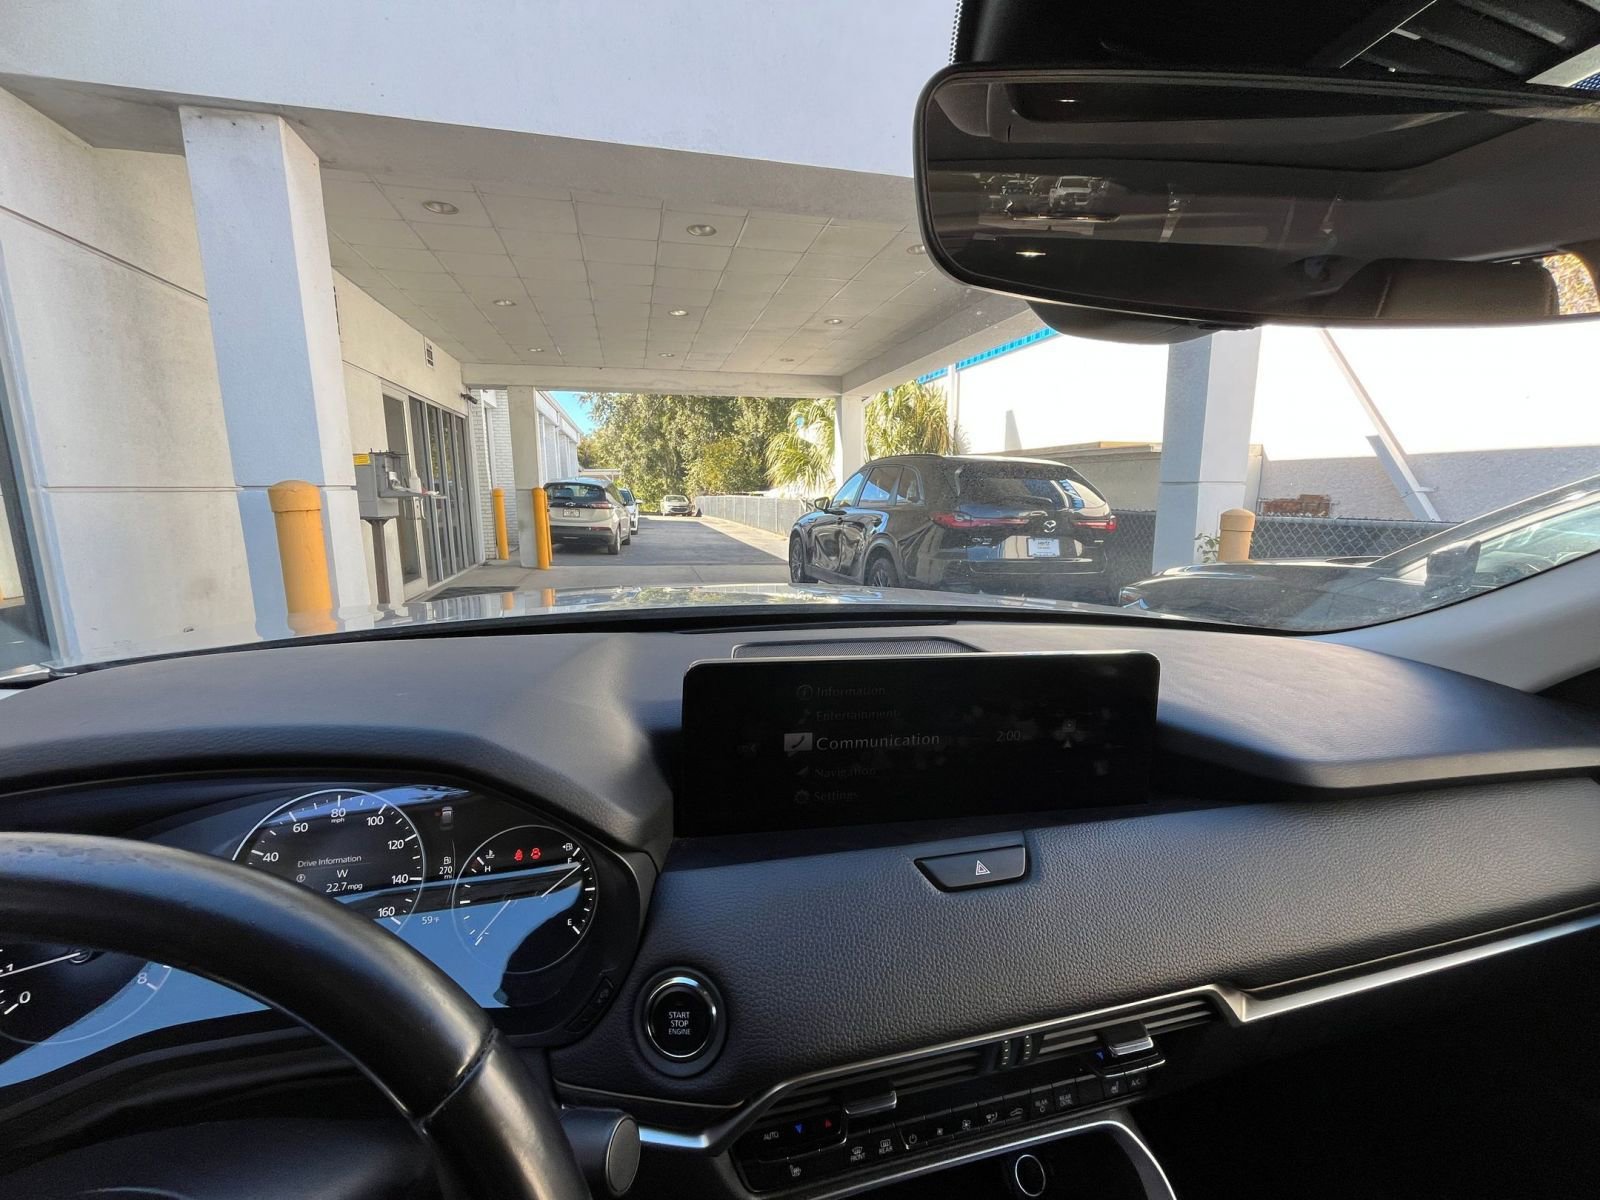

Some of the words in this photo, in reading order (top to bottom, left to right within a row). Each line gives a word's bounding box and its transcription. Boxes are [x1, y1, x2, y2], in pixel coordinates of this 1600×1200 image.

[816, 685, 886, 698] Information
[815, 732, 940, 751] Communication
[330, 807, 346, 818] 80
[366, 815, 384, 826] 100
[292, 822, 309, 833] 60
[388, 840, 405, 850] 120
[262, 851, 279, 862] 40
[297, 860, 317, 868] Drive
[318, 855, 362, 866] Information
[439, 866, 452, 875] 270
[391, 874, 409, 884] 140
[325, 882, 347, 893] 22.7
[347, 883, 363, 891] mpg
[378, 907, 396, 917] 160
[567, 918, 573, 926] E
[137, 972, 147, 984] 8
[20, 991, 31, 1004] 0
[668, 1011, 690, 1019] START
[670, 1019, 689, 1027] STOP
[763, 1130, 779, 1141] AUTO
